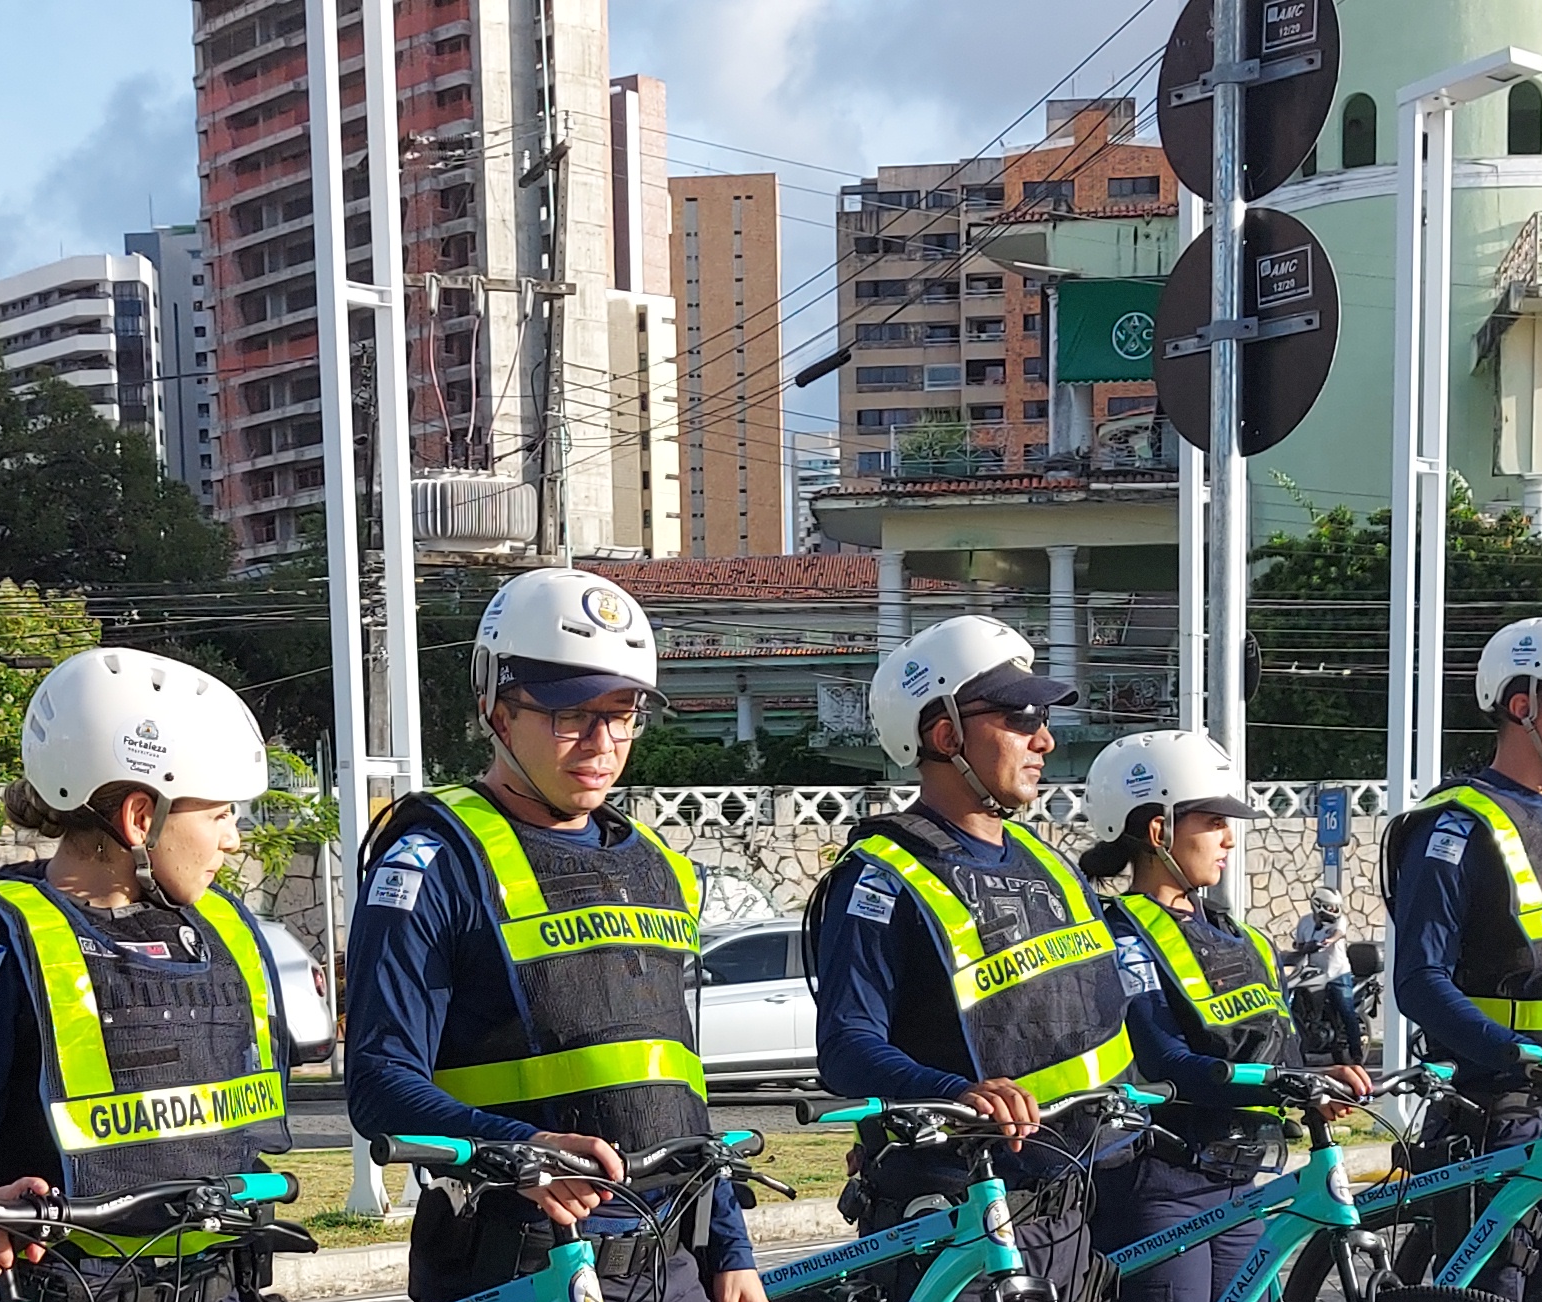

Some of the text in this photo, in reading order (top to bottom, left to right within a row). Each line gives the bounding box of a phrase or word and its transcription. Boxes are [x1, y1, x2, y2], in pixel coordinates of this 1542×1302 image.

[1276, 4, 1306, 22] AMC
[1270, 259, 1298, 278] AMC
[123, 735, 167, 754] Fortaleza
[1324, 811, 1338, 830] 16
[540, 913, 635, 950] GUARDA
[975, 928, 1102, 992] GUARDA MUNICIPAL
[1209, 986, 1273, 1021] GUARDA
[90, 1092, 208, 1139] GUARDA
[1111, 1206, 1225, 1265] LOPATRULHAMENTO
[1439, 1217, 1499, 1288] FORTALEZA
[761, 1237, 880, 1287] CLOPATRULHAMENTO
